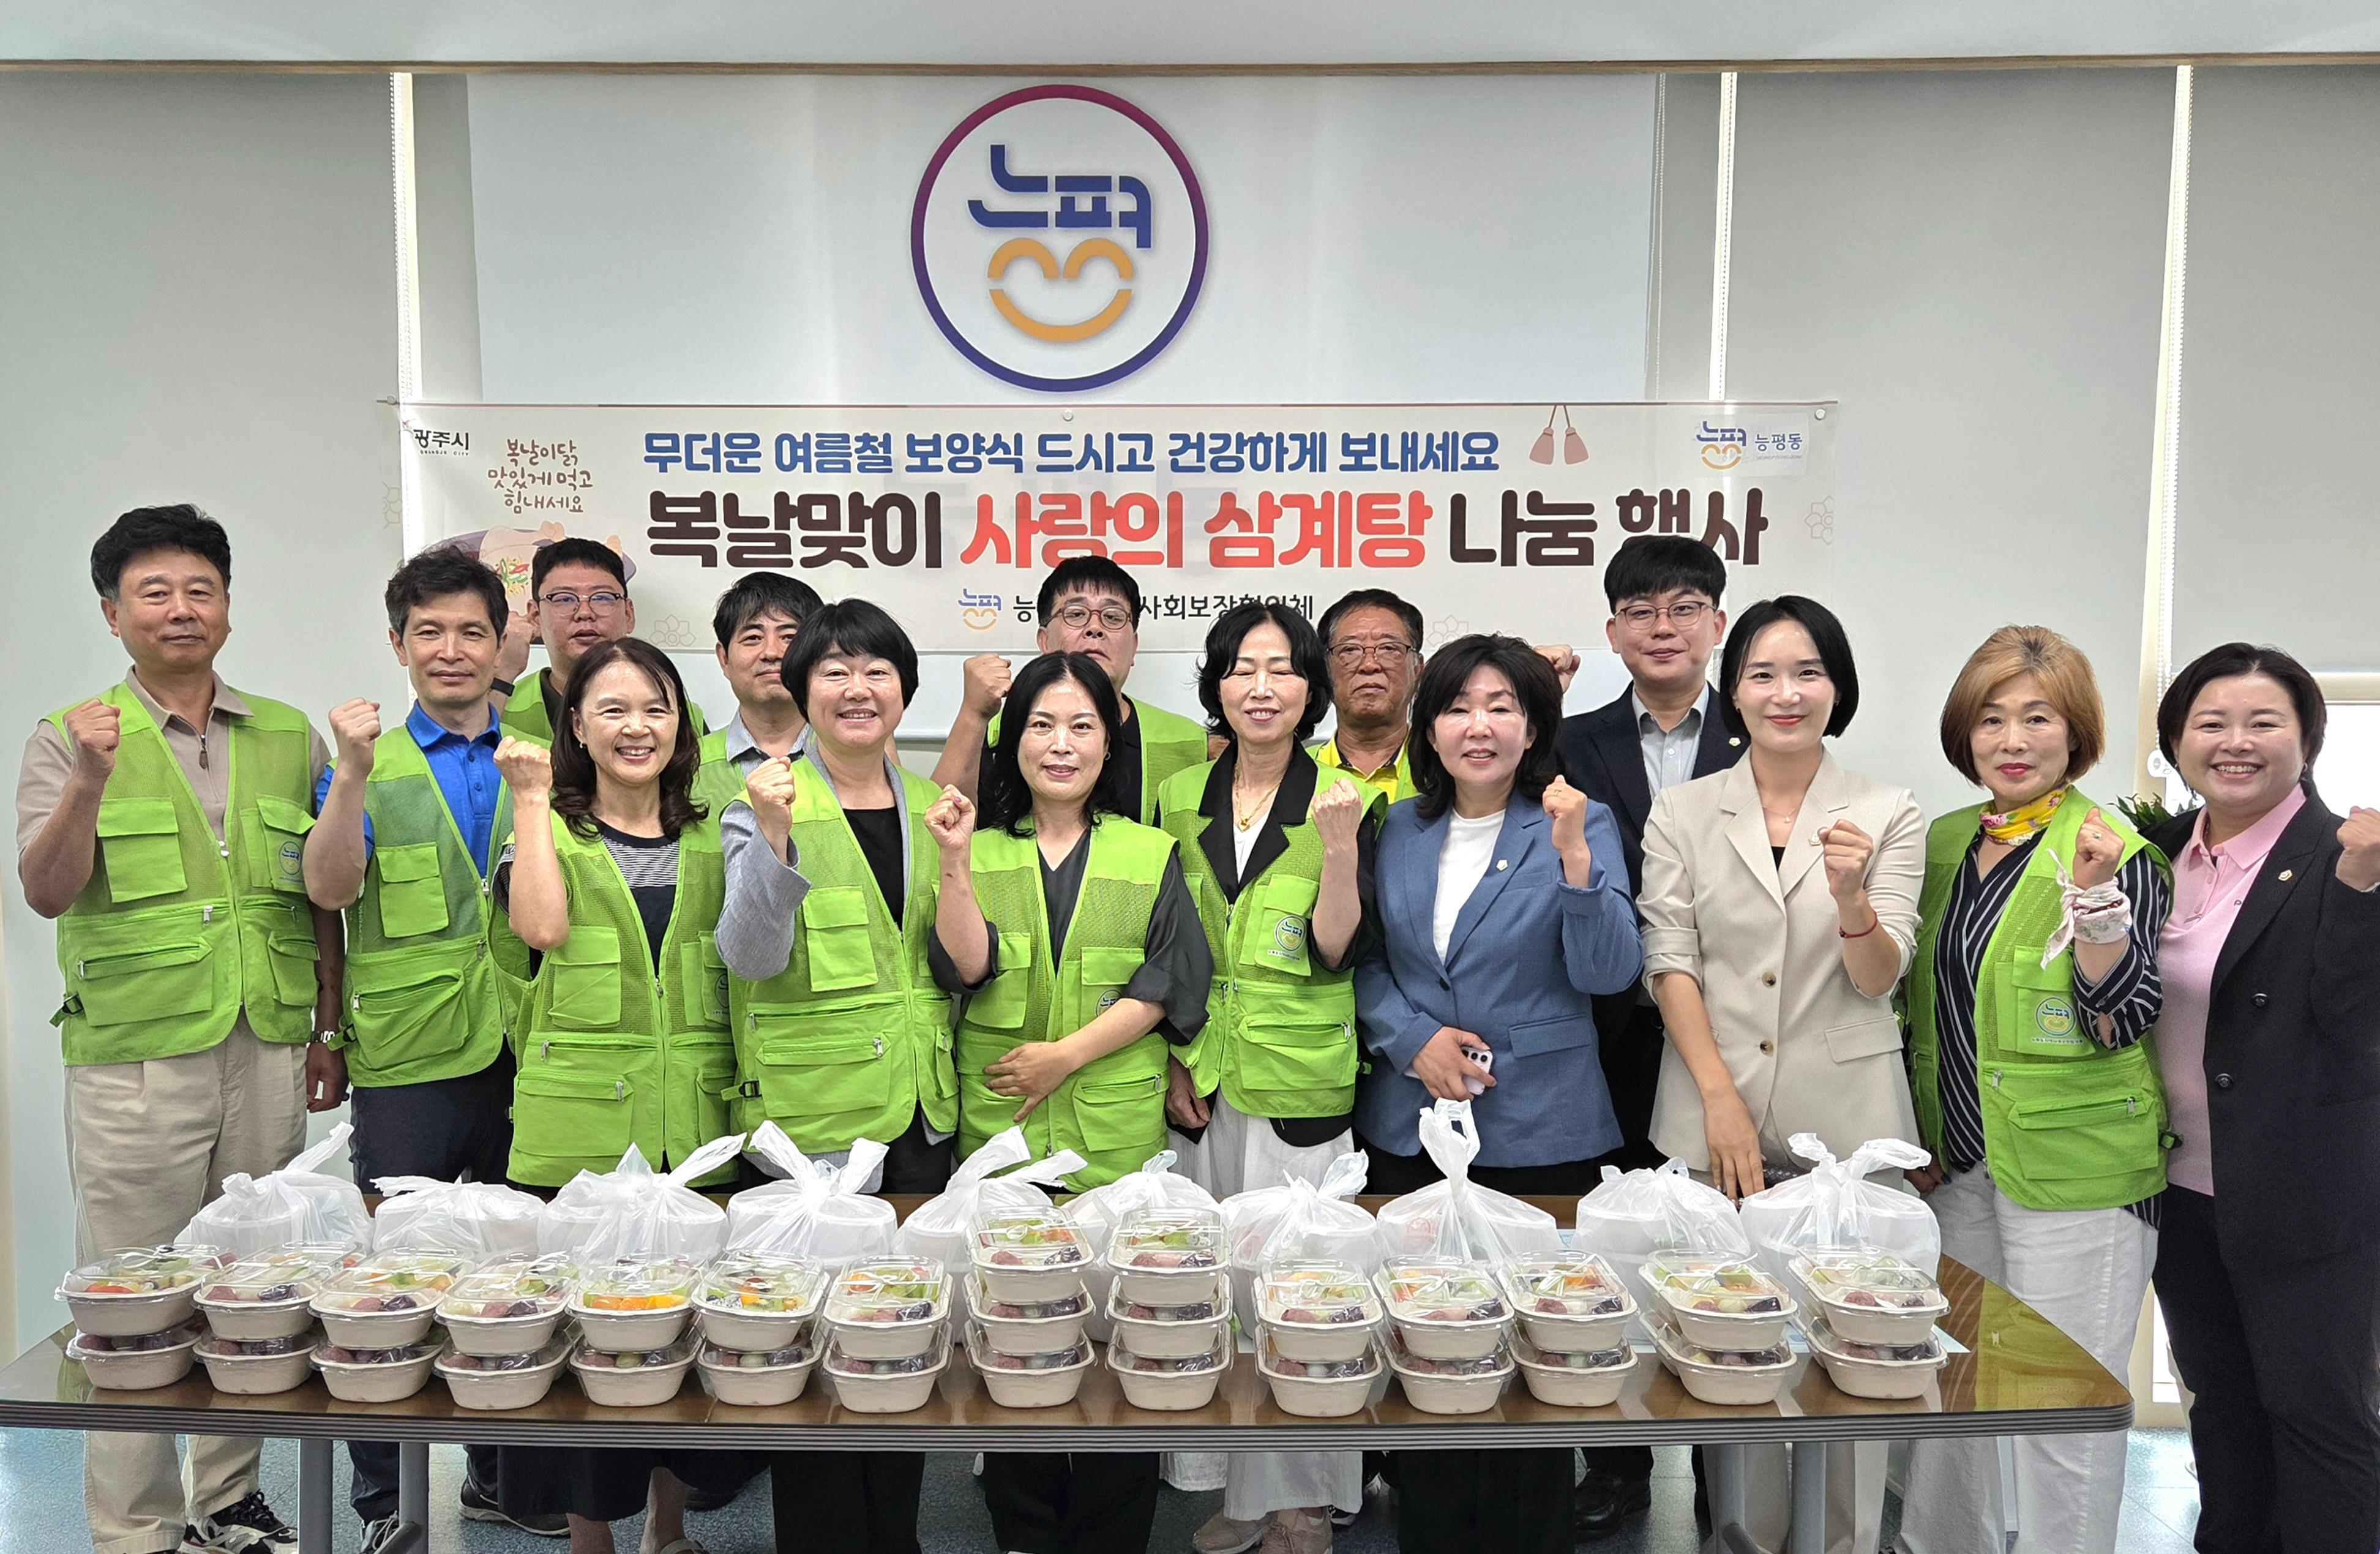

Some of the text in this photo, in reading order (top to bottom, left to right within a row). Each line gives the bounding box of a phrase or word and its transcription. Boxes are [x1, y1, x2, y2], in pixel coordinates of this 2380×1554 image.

[413, 429, 469, 451] 광주시
[507, 438, 578, 467] 복날이닭
[1755, 434, 1803, 452] 능평동
[643, 432, 1499, 474] 무더운 여름철 보양식 드시고 건강하게 보내세요
[488, 466, 593, 491] 맛있게 먹고
[504, 489, 583, 514] 힘내세요
[647, 490, 941, 569] 복날맞이
[960, 490, 1183, 569] 사랑의
[1205, 490, 1434, 569] 삼계탕
[1450, 490, 1597, 567] 나눔
